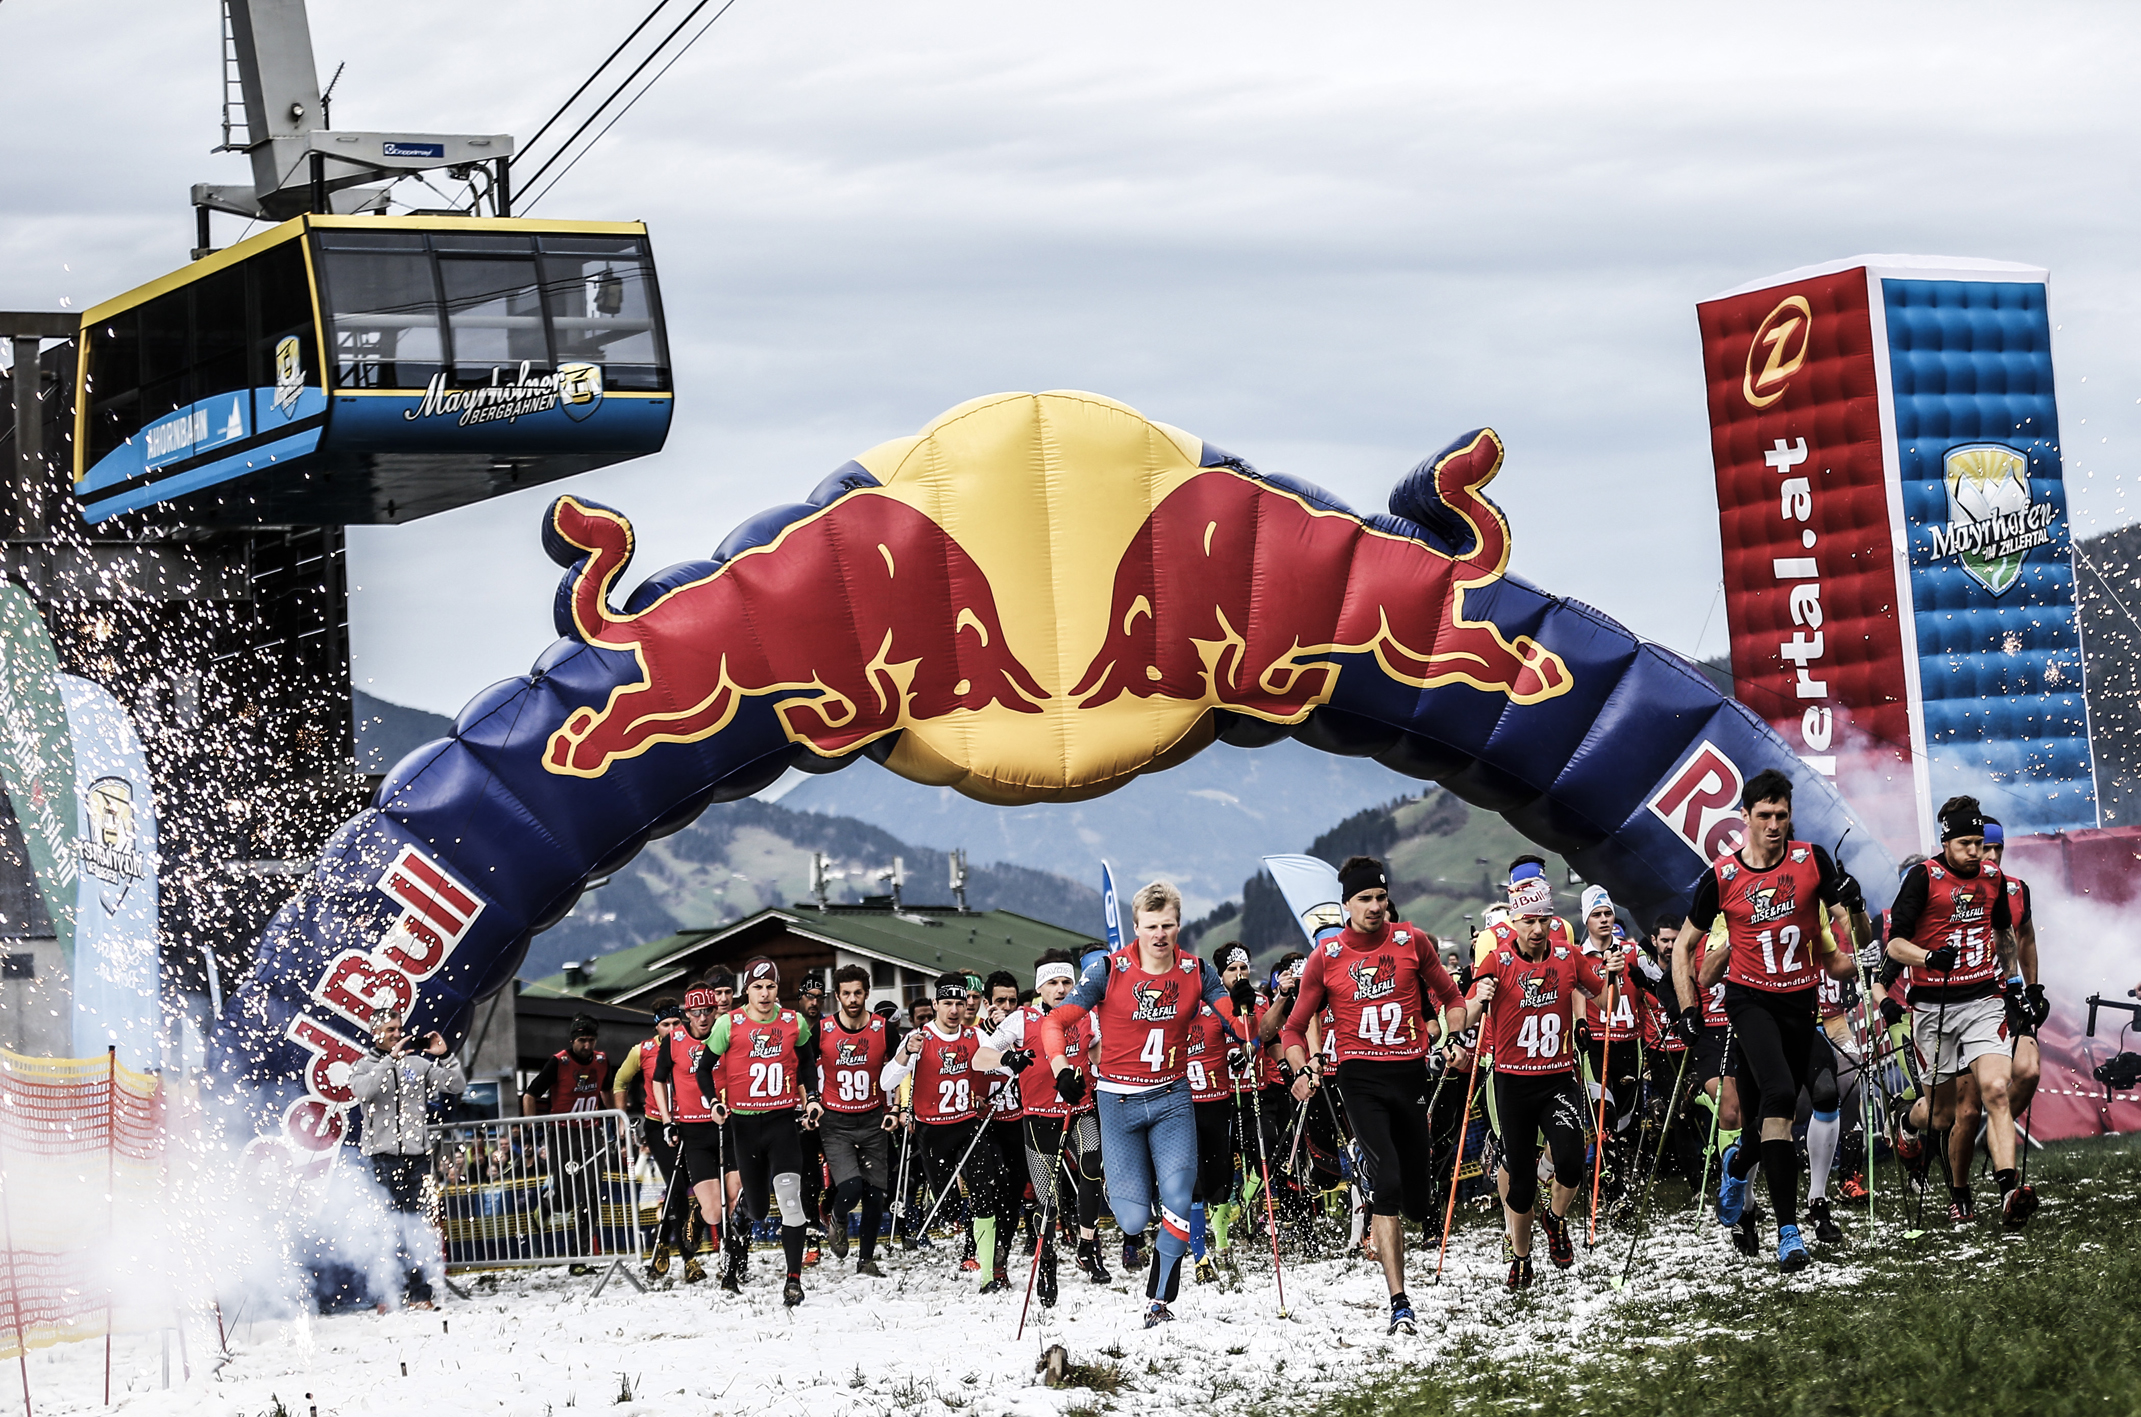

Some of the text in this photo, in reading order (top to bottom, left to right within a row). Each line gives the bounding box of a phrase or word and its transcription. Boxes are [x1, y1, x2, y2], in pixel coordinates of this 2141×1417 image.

[469, 394, 558, 424] BERGBAHNEN
[147, 408, 208, 460] AHORNBAHN
[1928, 499, 2052, 560] Mayrhofen
[1999, 529, 2049, 557] ZILLERTAL
[1764, 437, 1837, 788] lertal.at
[1655, 748, 1748, 869] Re
[1519, 890, 1546, 906] Bull
[1750, 899, 1796, 925] RISE&FALL
[324, 852, 481, 1028] Bull
[1756, 925, 1803, 974] 12
[1353, 978, 1396, 1001] RISE&FALL
[1519, 990, 1559, 1009] RISE&FALL
[1132, 1005, 1178, 1021] RISE&FALL
[1358, 1002, 1406, 1046] 42
[749, 1044, 783, 1058] RISE&FALL
[1140, 1028, 1165, 1072] 4
[1517, 1013, 1561, 1058] 48
[835, 1055, 868, 1066] RISE&FALL
[939, 1061, 968, 1075] RISE&FALL
[1499, 1060, 1571, 1072] www.riseandfall.at
[749, 1062, 783, 1098] 20
[836, 1070, 870, 1101] 39
[938, 1079, 970, 1113] 28
